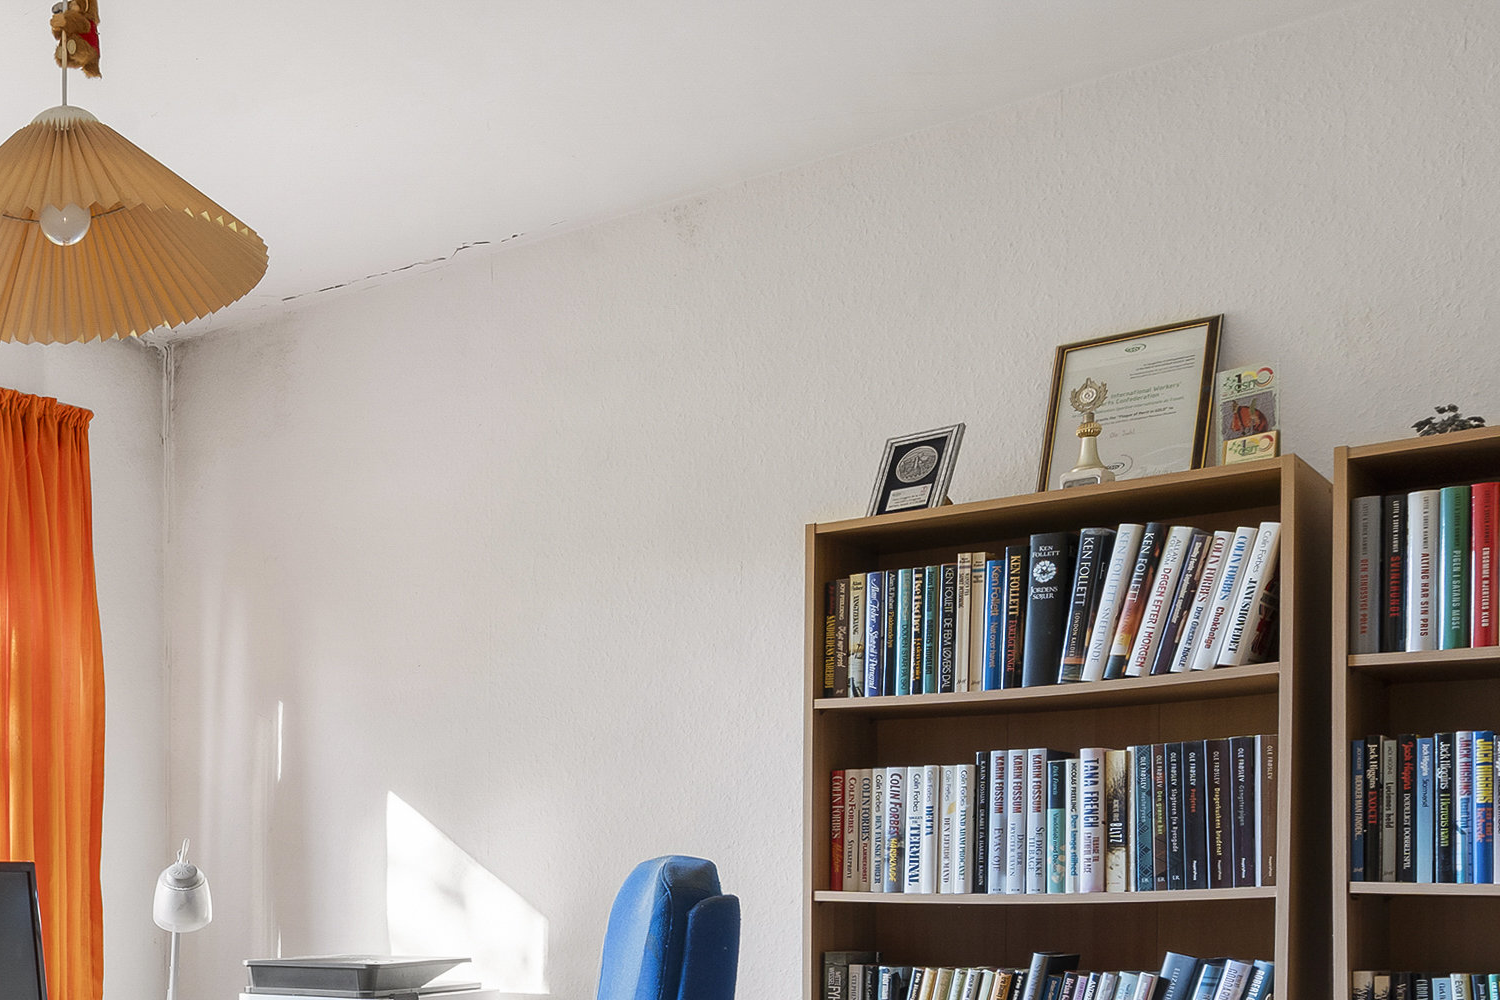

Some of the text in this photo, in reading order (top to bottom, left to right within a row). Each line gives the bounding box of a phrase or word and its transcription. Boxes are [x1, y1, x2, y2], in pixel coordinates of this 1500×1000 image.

[1010, 555, 1020, 574] KEN
[1452, 550, 1461, 572] PIGEN
[1009, 576, 1020, 616] FOLLETT
[1158, 567, 1172, 598] DAGEN
[1420, 553, 1429, 637] ALTING HAR SIN PRIS
[1452, 580, 1460, 607] SATANS
[1135, 630, 1153, 668] MORGEN
[1368, 744, 1377, 760] Jack
[994, 756, 1004, 814] KARIN FOSSUM
[1012, 755, 1023, 813] KARIN FOSSUM
[1476, 739, 1493, 803] JACK HIGGINS
[1084, 758, 1099, 828] TANA FRENCH
[1368, 791, 1377, 824] EXOCET
[1109, 823, 1123, 843] BLITZ
[908, 824, 920, 886] TERMINAL
[1455, 980, 1464, 997] Evan
